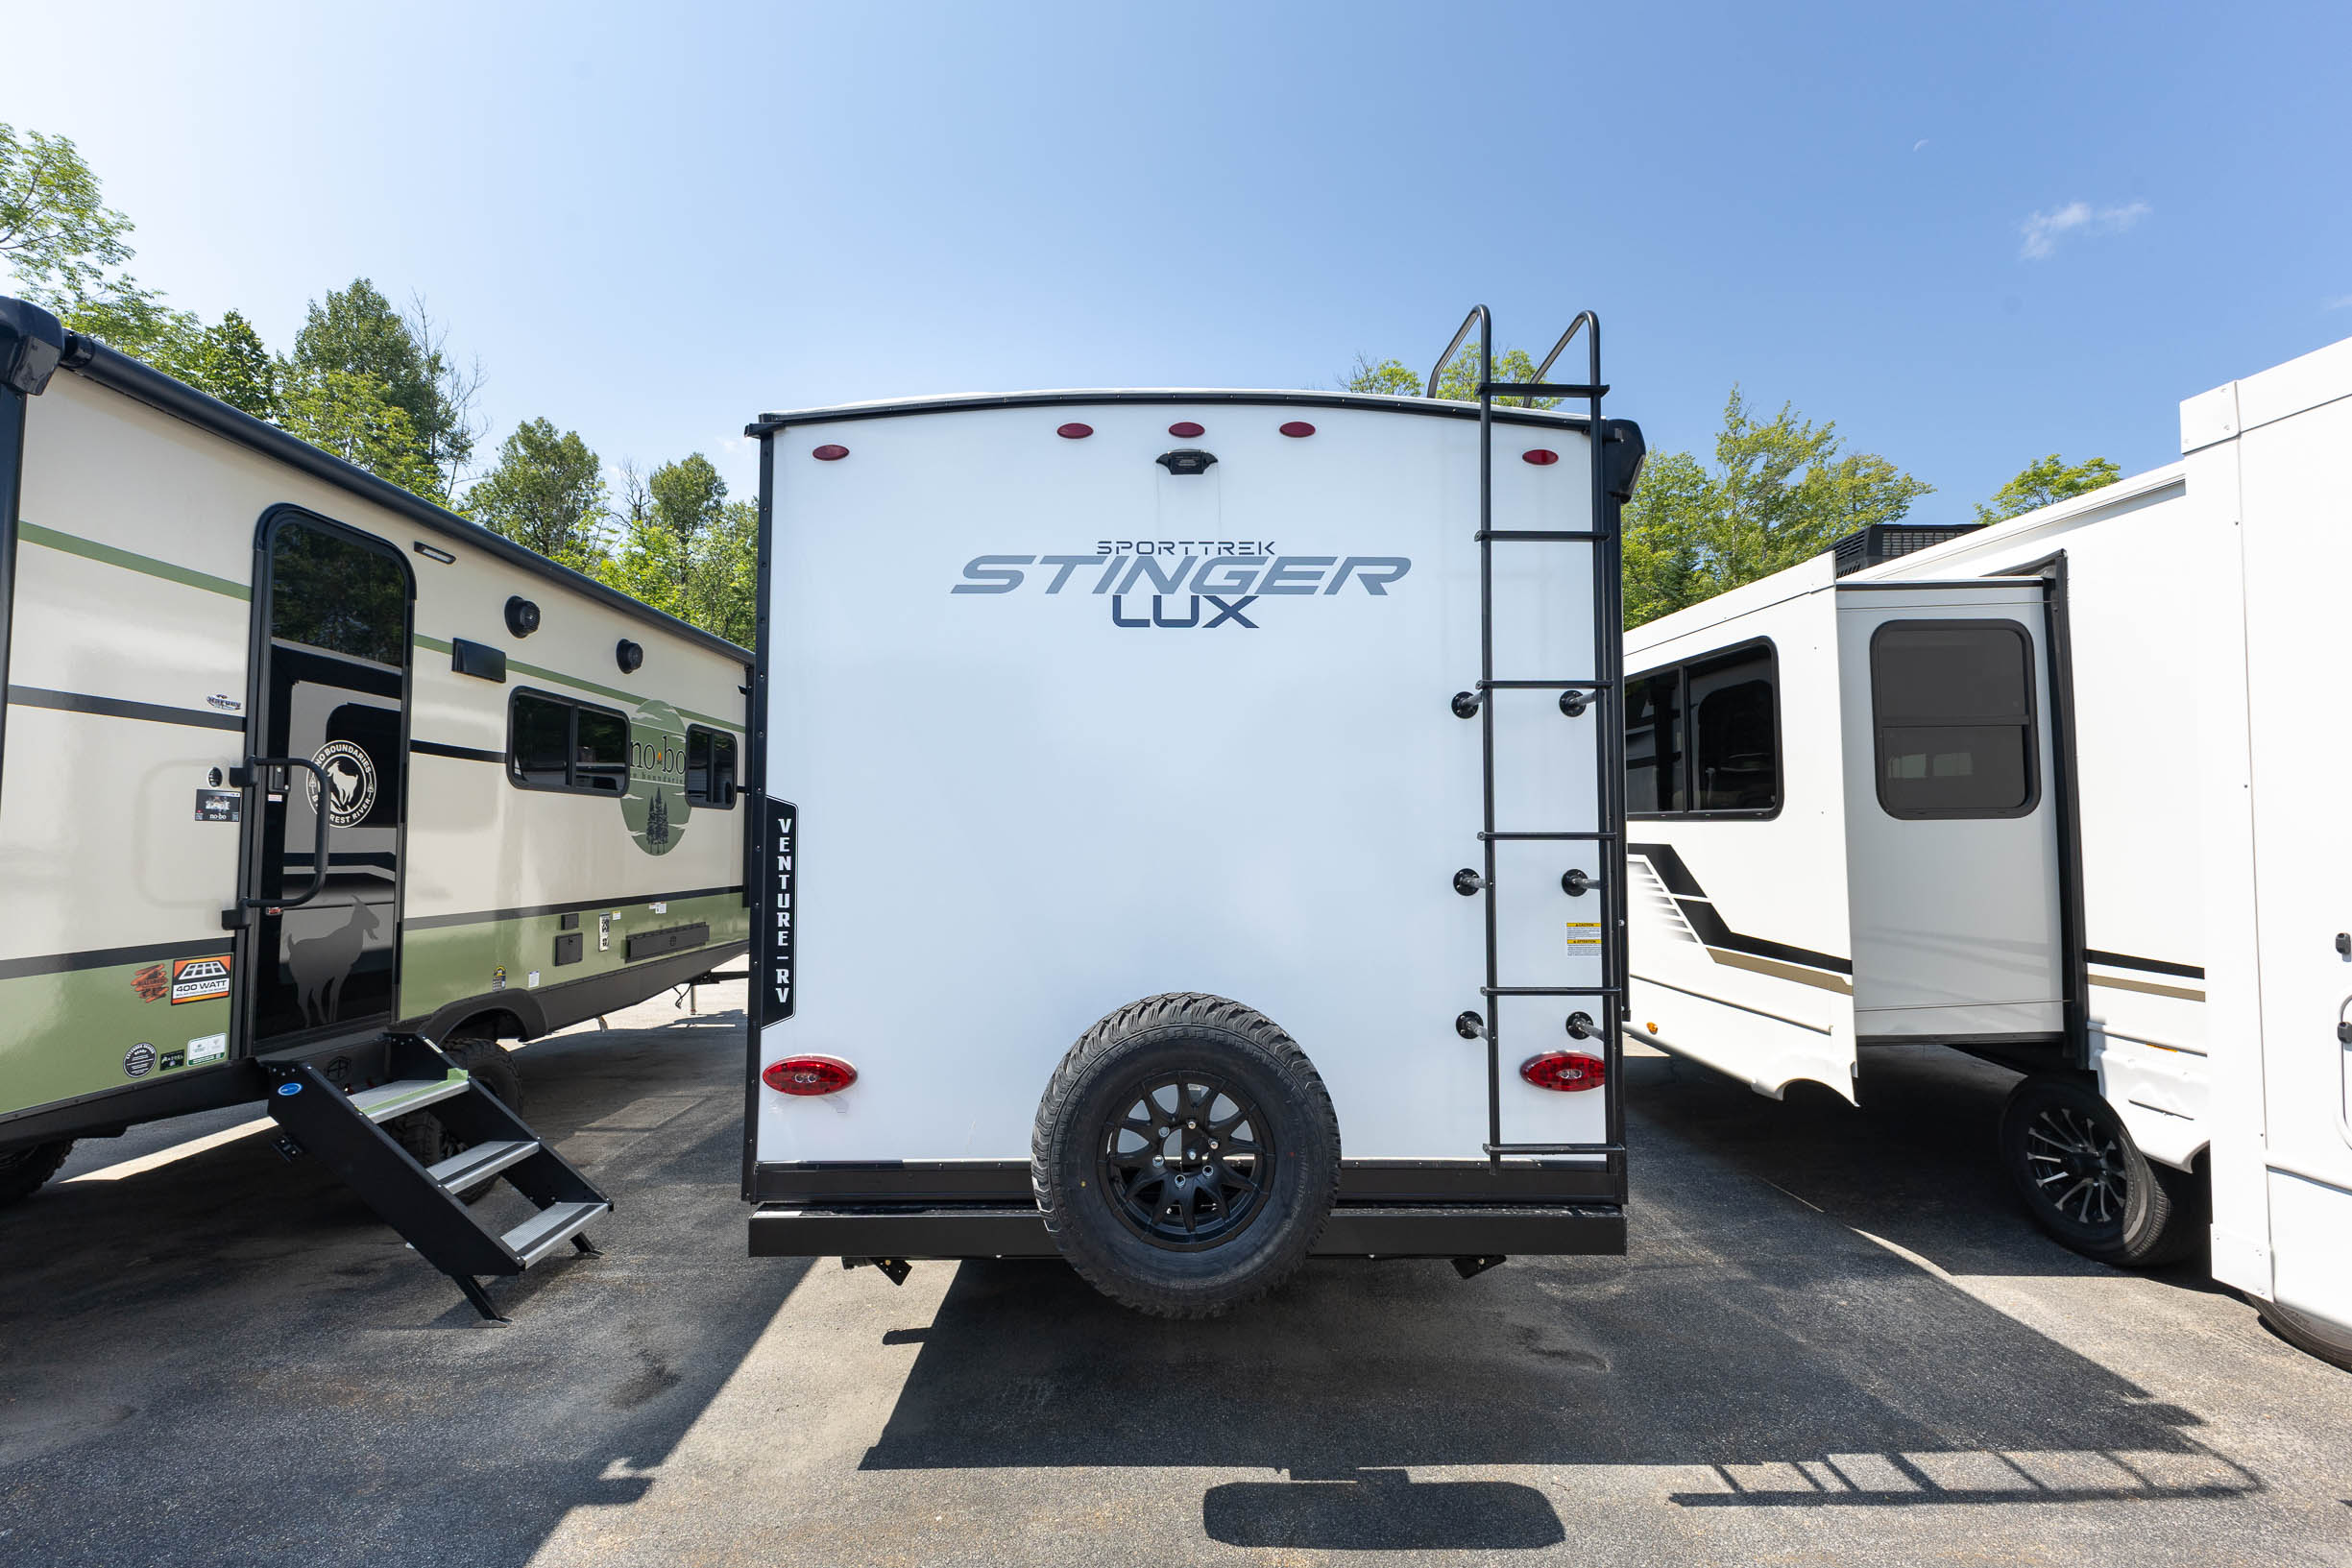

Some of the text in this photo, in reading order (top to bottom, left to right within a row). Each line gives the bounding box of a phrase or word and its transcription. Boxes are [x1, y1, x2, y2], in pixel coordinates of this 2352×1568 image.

[1097, 541, 1275, 555] SPORTTREK
[950, 555, 1412, 595] STINGER
[1112, 595, 1260, 629] LUX
[315, 744, 372, 773] NO BOUNDARIES
[329, 814, 351, 823] REST
[352, 798, 371, 820] RIVER
[200, 979, 227, 989] WATT
